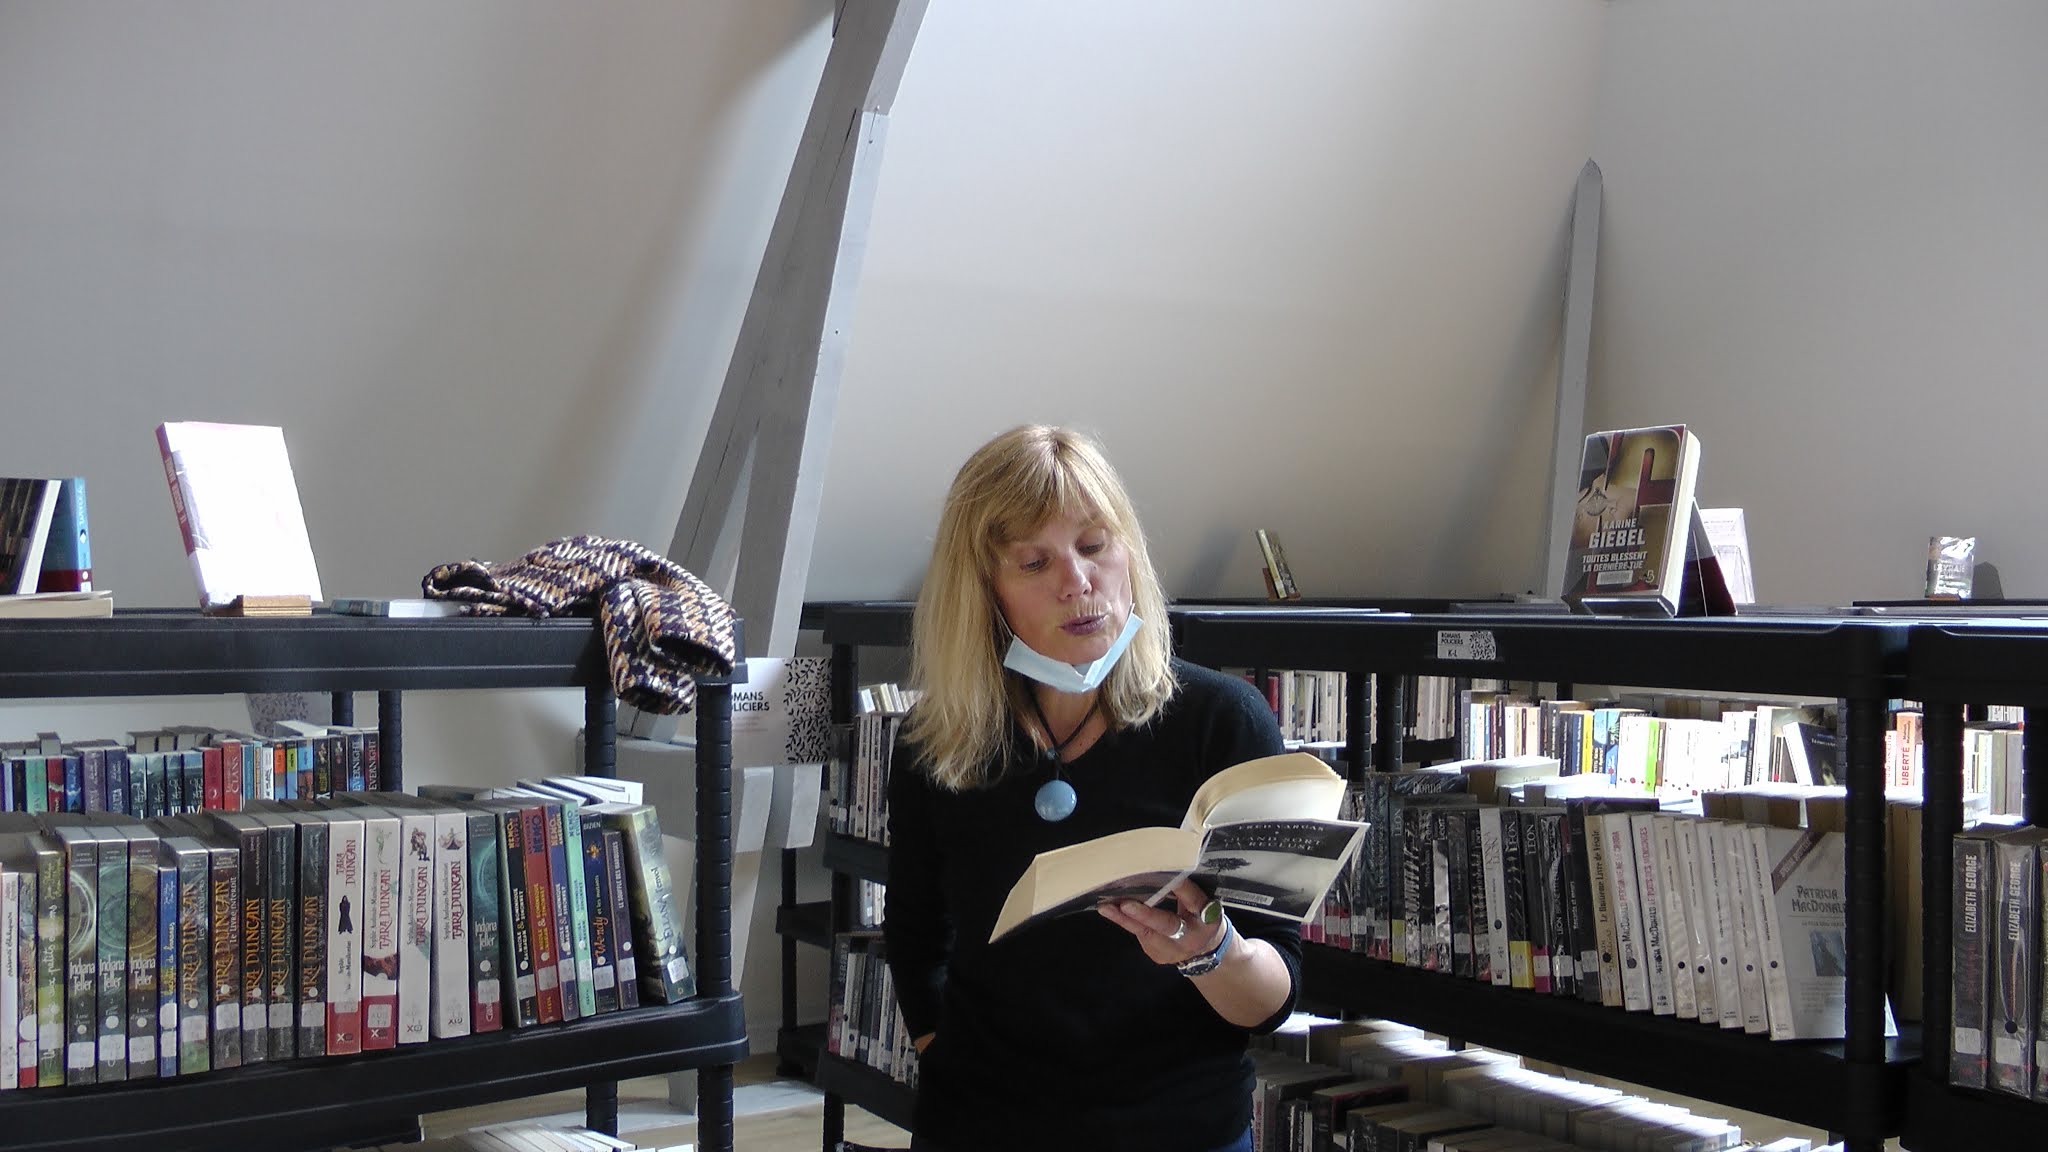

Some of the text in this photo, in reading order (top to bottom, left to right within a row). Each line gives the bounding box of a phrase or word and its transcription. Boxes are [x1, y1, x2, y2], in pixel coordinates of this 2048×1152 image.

[1603, 518, 1637, 529] KARINE
[1589, 530, 1645, 548] GIEBEL
[1583, 551, 1647, 563] TOUTES BLESSENT
[1583, 563, 1592, 572] LA
[1629, 561, 1643, 570] TUE
[1448, 649, 1457, 657] K-L
[732, 691, 764, 702] MANS
[732, 701, 770, 712] LICIERS
[231, 756, 239, 794] CLANS
[352, 740, 361, 791] EVERNIGHT
[369, 740, 377, 790] EVERNIGHT
[1901, 747, 1910, 786] LIBERTÉ
[1412, 781, 1442, 795] Donna
[532, 815, 543, 853] NEMO
[549, 818, 558, 846] NEMO
[1276, 823, 1325, 832] VARGAS
[1393, 808, 1402, 837] LEON
[1438, 818, 1446, 841] Leon
[507, 824, 515, 849] NEMO
[1526, 824, 1537, 855] LEON
[335, 852, 344, 875] TARA
[344, 838, 357, 886] DUNCAN
[1594, 852, 1602, 861] de
[1595, 862, 1603, 880] Livre
[1965, 854, 1978, 890] GEORGE
[450, 860, 465, 940] TARA DUNCAN
[616, 880, 624, 902] SOUFFLE
[1796, 885, 1838, 900] PATRICIA
[2008, 861, 2021, 941] ELIZABETH GEORGE
[379, 868, 392, 950] TARA DUNCAN
[415, 865, 429, 946] TARA DUNCAN
[618, 901, 625, 909] LE
[1791, 899, 1845, 914] MACDONAL
[1965, 891, 1977, 933] ELIZABETH
[475, 917, 497, 937] Indiana
[1599, 914, 1607, 923] Le
[182, 882, 202, 1004] TARA DUNCAN
[214, 879, 234, 1002] TARA DUNCAN
[478, 934, 494, 951] Teller
[593, 916, 608, 957] Wendy
[43, 944, 61, 973] petits
[245, 898, 264, 1005] TARA DUNCAN
[271, 898, 289, 1004] TARA DUNCAN
[303, 895, 321, 1004] TARA DUNCAN
[70, 956, 95, 979] Indiana
[99, 954, 125, 976] Indiana
[130, 953, 155, 974] Indiana
[73, 974, 92, 993] Teller
[103, 971, 121, 992] Teller
[134, 970, 152, 990] Teller
